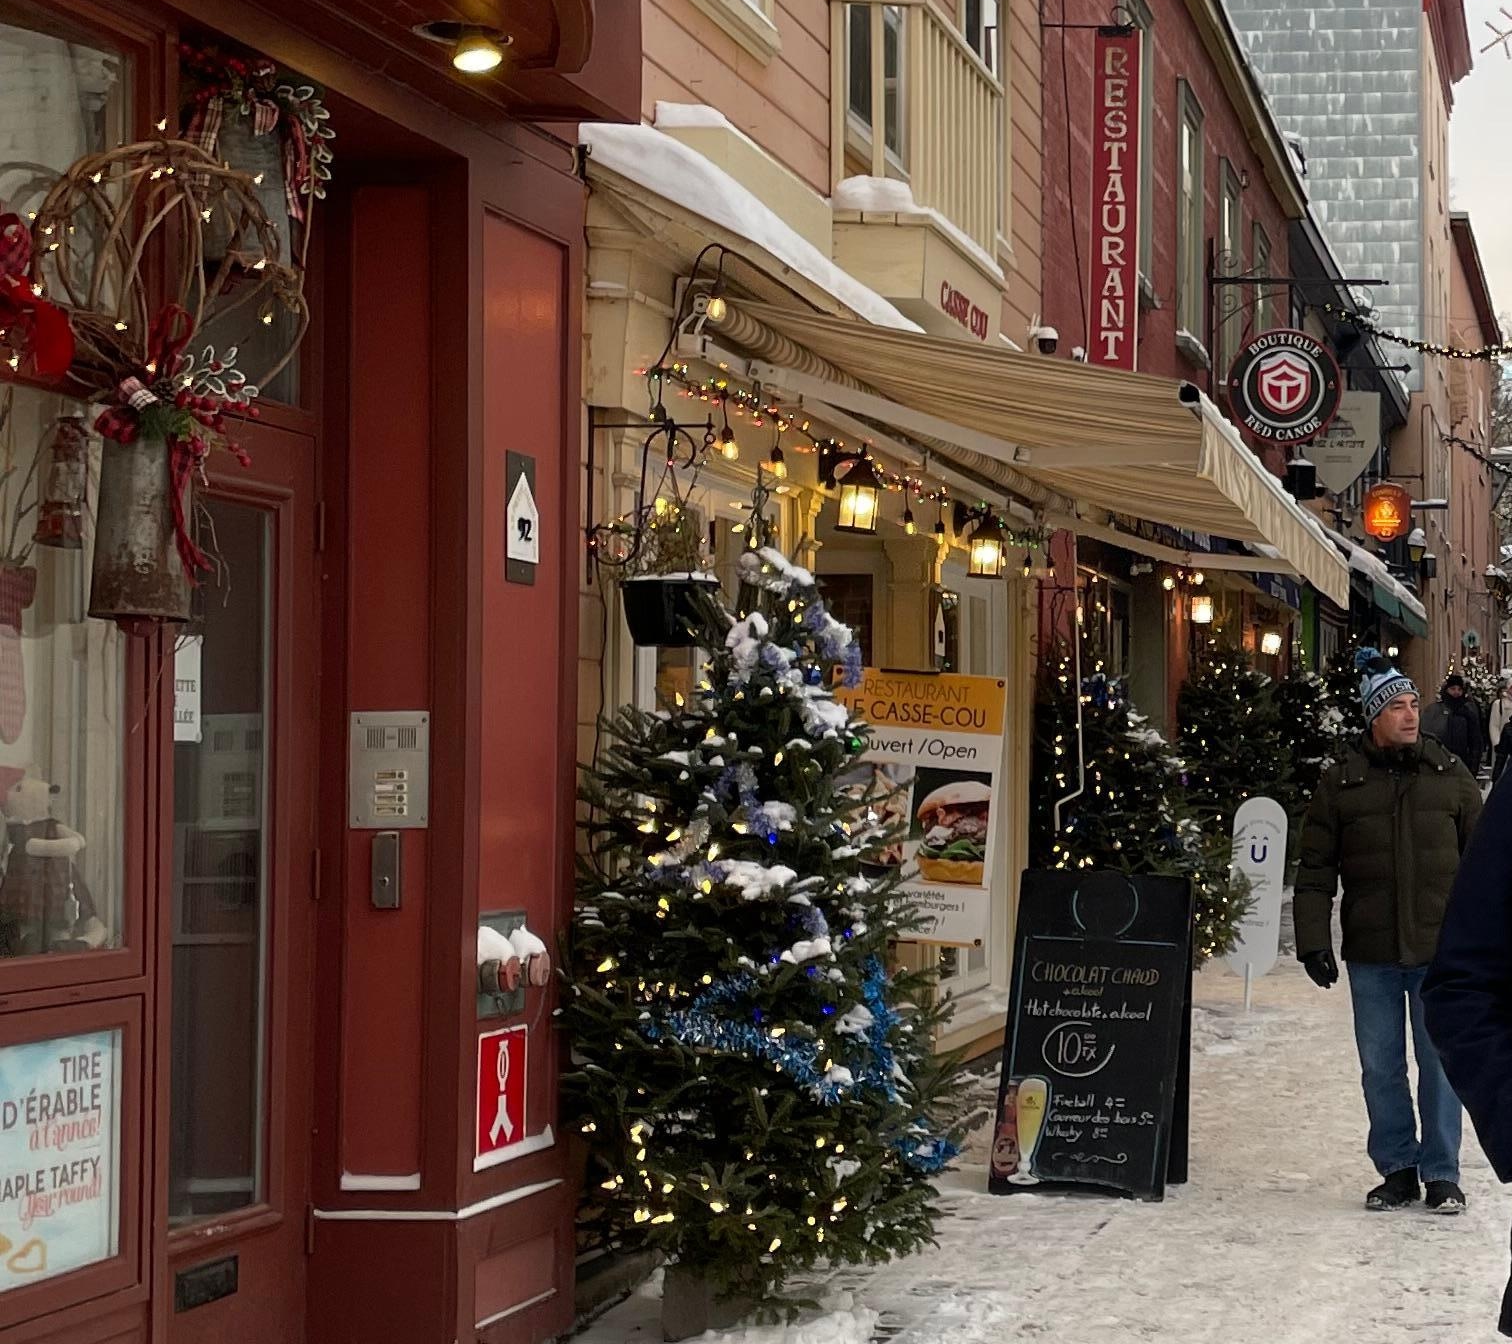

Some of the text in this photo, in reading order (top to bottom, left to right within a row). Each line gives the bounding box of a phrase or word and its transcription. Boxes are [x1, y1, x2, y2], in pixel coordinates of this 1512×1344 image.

[1100, 46, 1130, 361] RESTAURANT
[1248, 333, 1323, 359] BOUTIQUE
[1244, 414, 1323, 441] RED CANOE
[864, 678, 971, 704] RESTAURANT
[870, 700, 986, 729] CASSE-COU
[1031, 960, 1160, 987] CHOCOLAT CHAUD
[1024, 998, 1050, 1017] Hot
[59, 1050, 101, 1085] TIRE
[2, 1083, 101, 1131] D'ÉRABLE
[0, 1155, 101, 1203] APLE TAFFY
